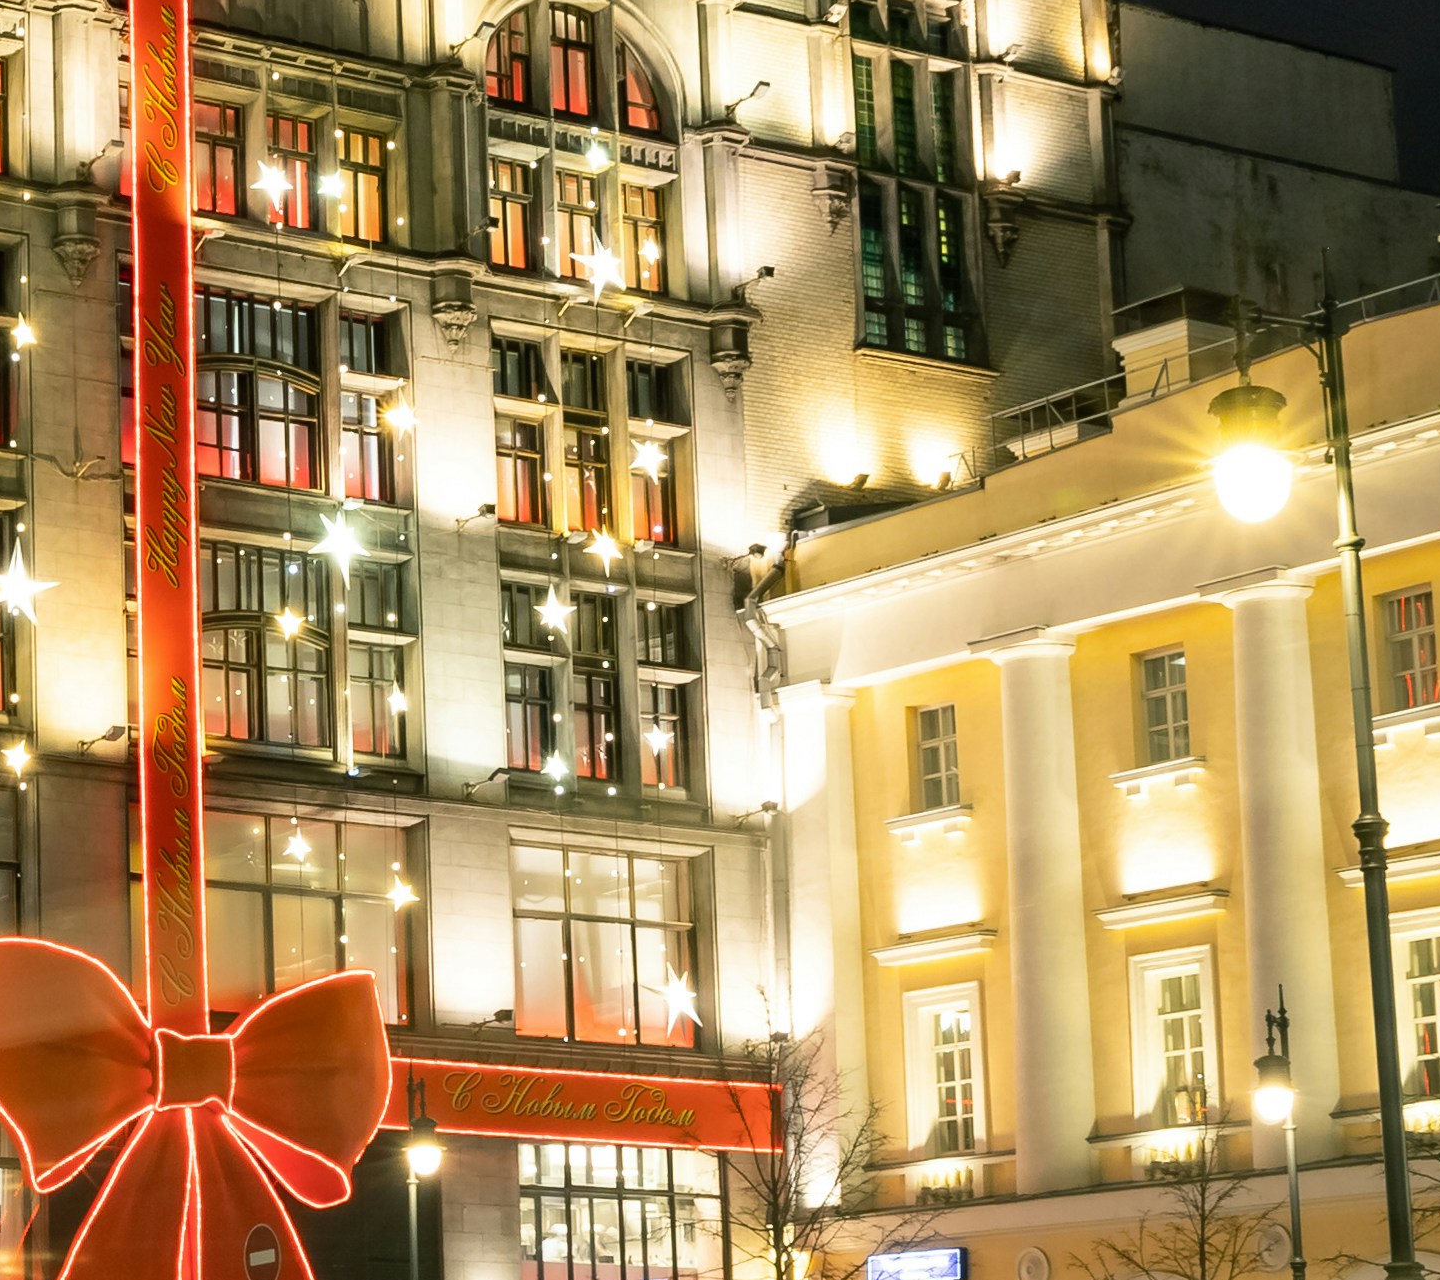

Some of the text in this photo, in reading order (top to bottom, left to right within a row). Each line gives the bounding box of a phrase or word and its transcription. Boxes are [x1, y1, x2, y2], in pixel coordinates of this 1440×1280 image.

[143, 283, 188, 589] Happy New Year
[441, 1071, 696, 1128] С Новым Годом
